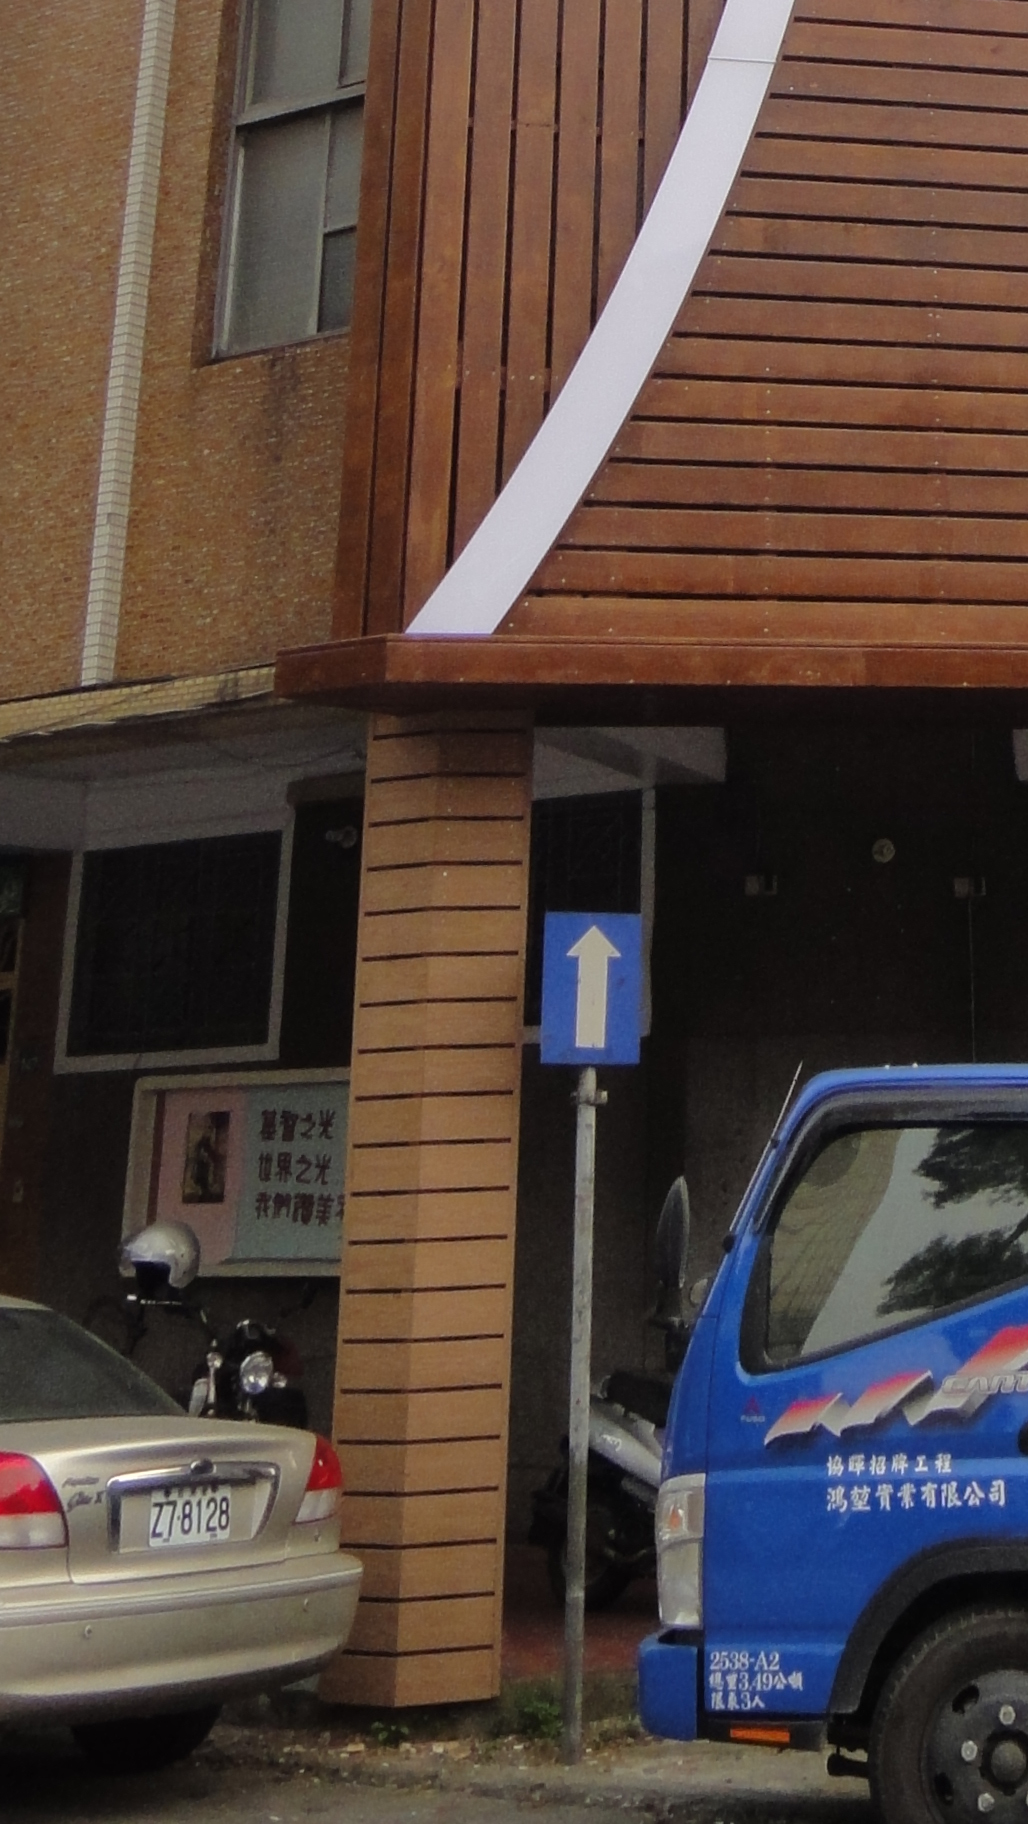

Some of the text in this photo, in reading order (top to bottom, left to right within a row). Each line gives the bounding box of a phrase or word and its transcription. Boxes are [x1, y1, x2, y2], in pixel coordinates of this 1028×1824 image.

[257, 1151, 333, 1186] 世界之光
[709, 1651, 780, 1672] 2538-A2
